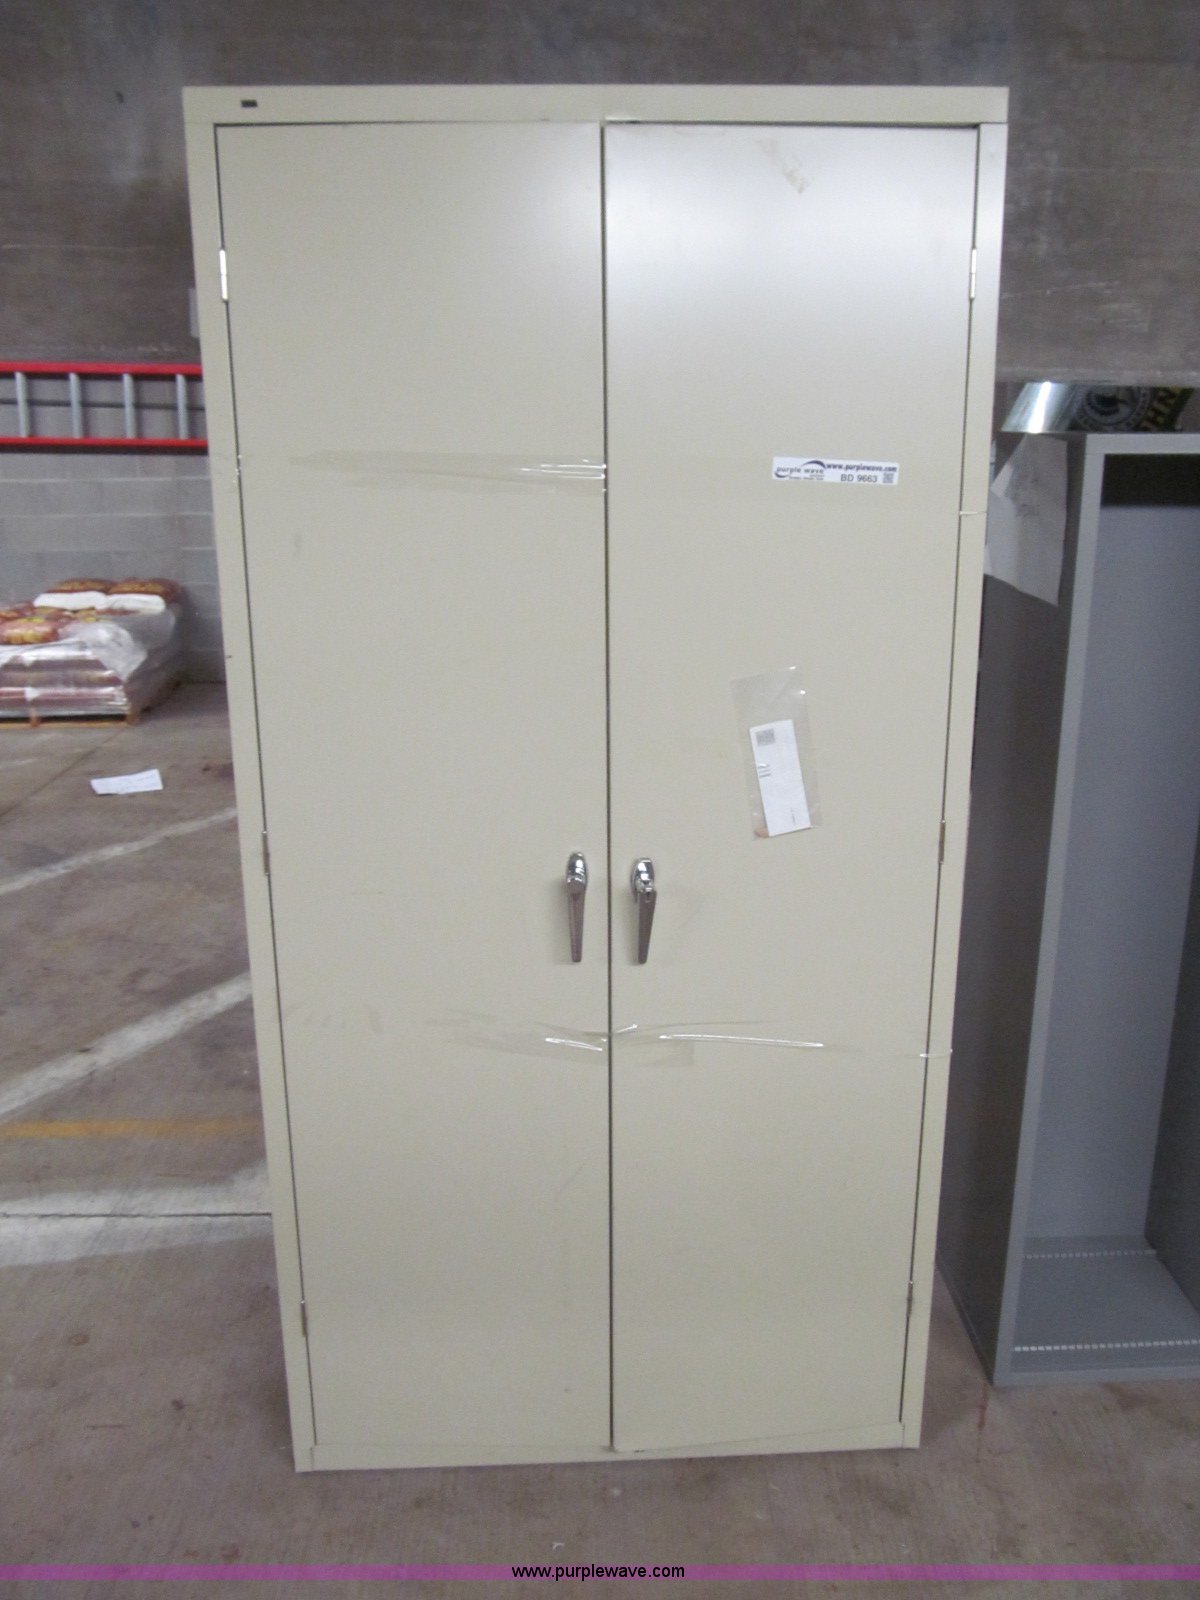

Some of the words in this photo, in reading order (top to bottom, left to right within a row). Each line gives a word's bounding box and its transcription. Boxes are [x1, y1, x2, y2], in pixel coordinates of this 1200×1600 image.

[776, 466, 801, 475] purple
[826, 463, 897, 472] www.purplewave.com
[840, 473, 854, 482] BD
[857, 474, 878, 483] 9663
